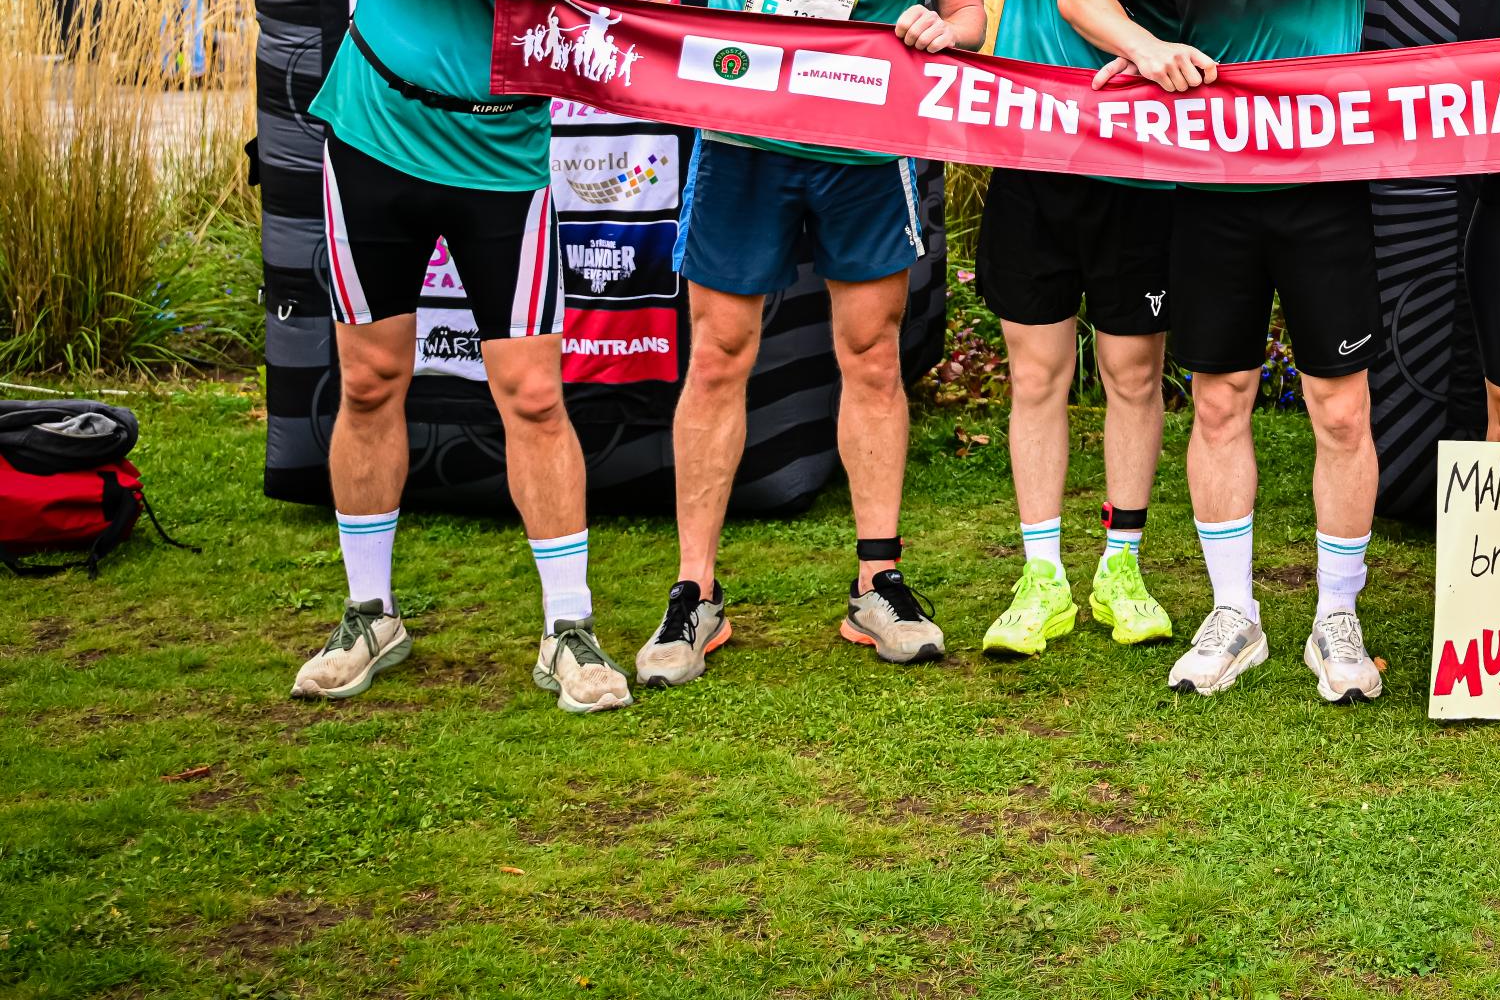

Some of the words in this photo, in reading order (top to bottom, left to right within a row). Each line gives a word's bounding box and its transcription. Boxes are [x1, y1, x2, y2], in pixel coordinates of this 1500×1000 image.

[810, 69, 884, 87] MAINTRANS
[472, 104, 514, 114] KIPRUN
[917, 62, 1080, 136] ZEHN
[1098, 89, 1375, 153] FREUNDE
[551, 151, 629, 172] aworld
[566, 244, 637, 273] WANDER
[583, 268, 621, 281] EVENT
